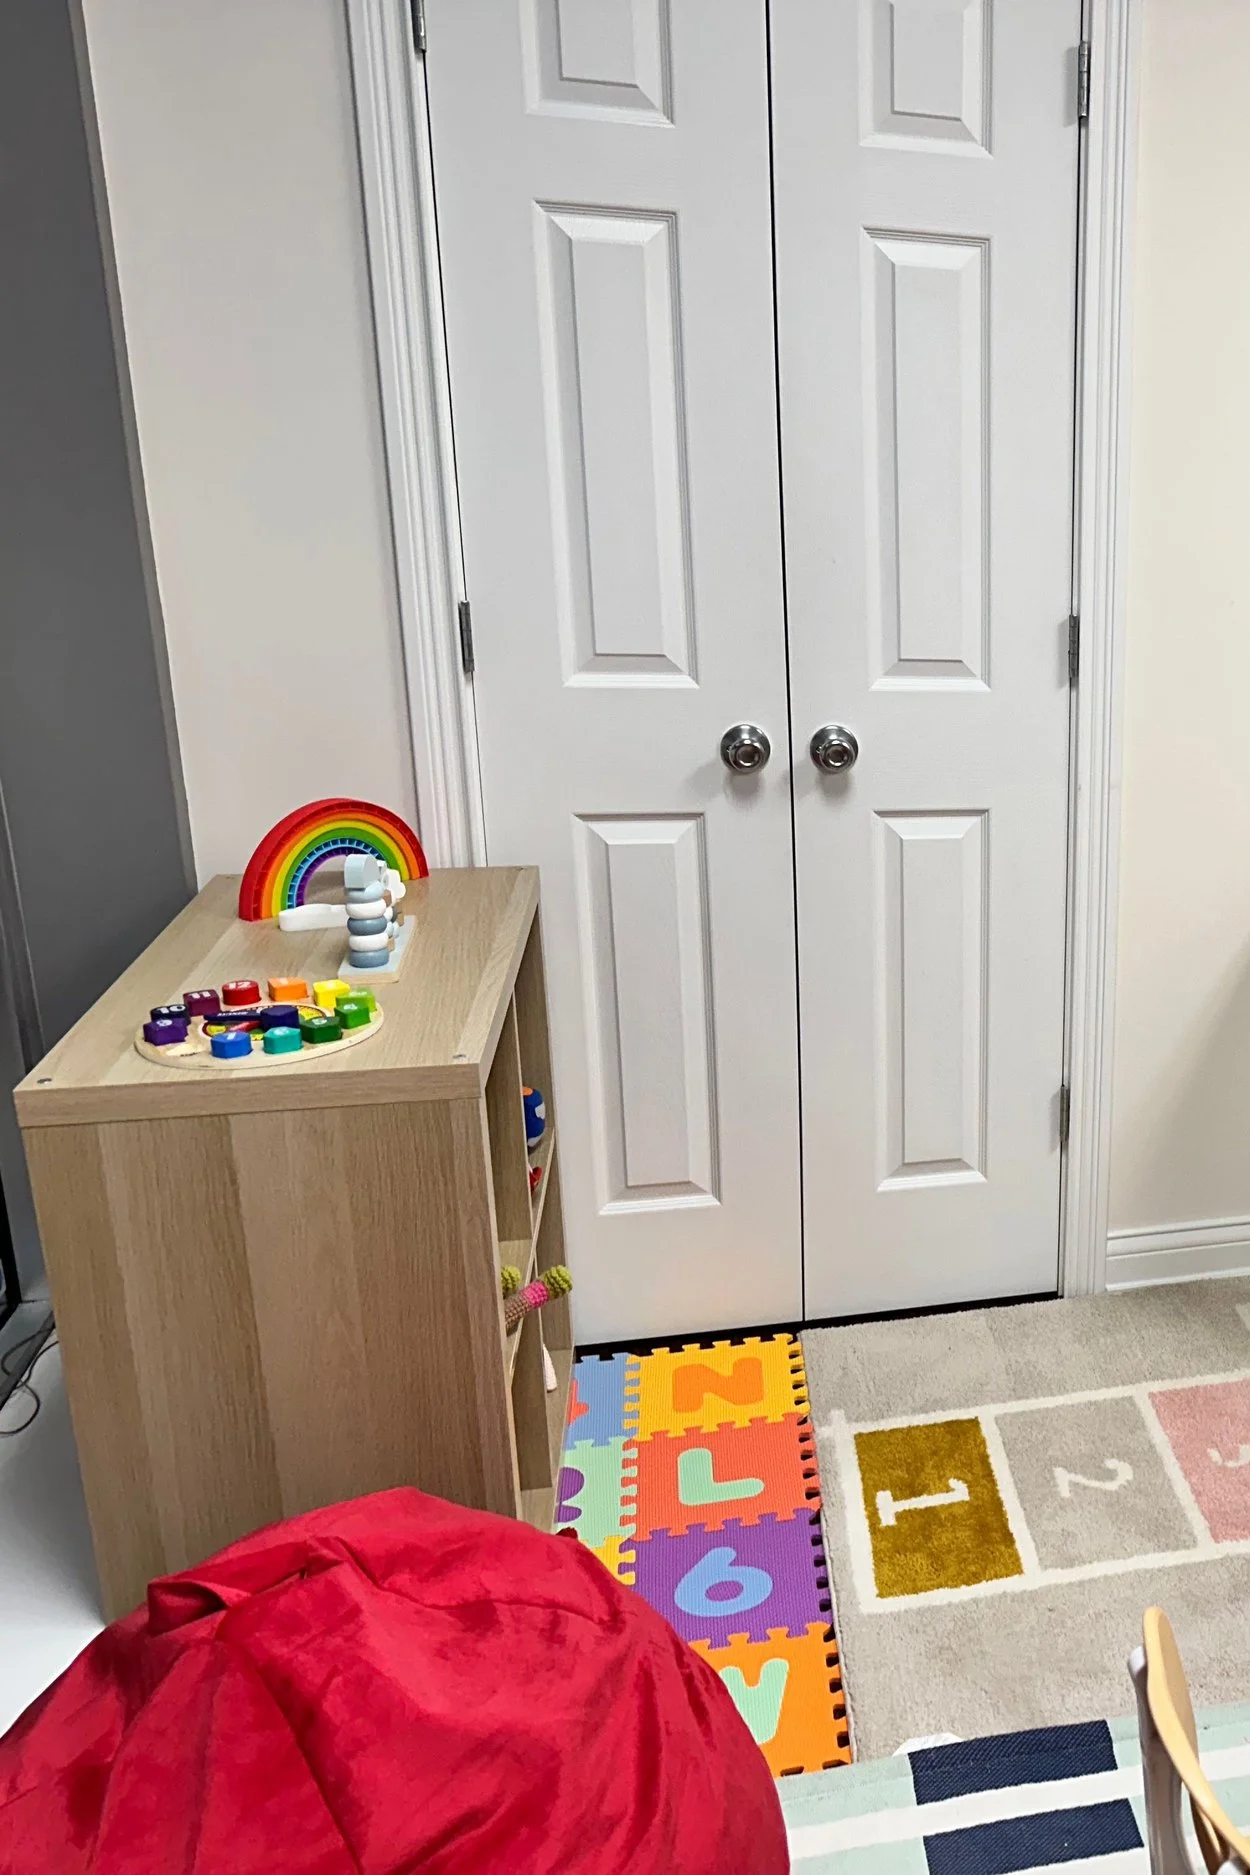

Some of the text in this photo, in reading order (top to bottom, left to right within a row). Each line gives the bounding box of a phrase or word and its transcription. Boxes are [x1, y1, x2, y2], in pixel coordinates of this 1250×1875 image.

[677, 1448, 765, 1506] L
[875, 1478, 970, 1527] 1
[1053, 1458, 1134, 1499] 2
[674, 1546, 773, 1617] 6
